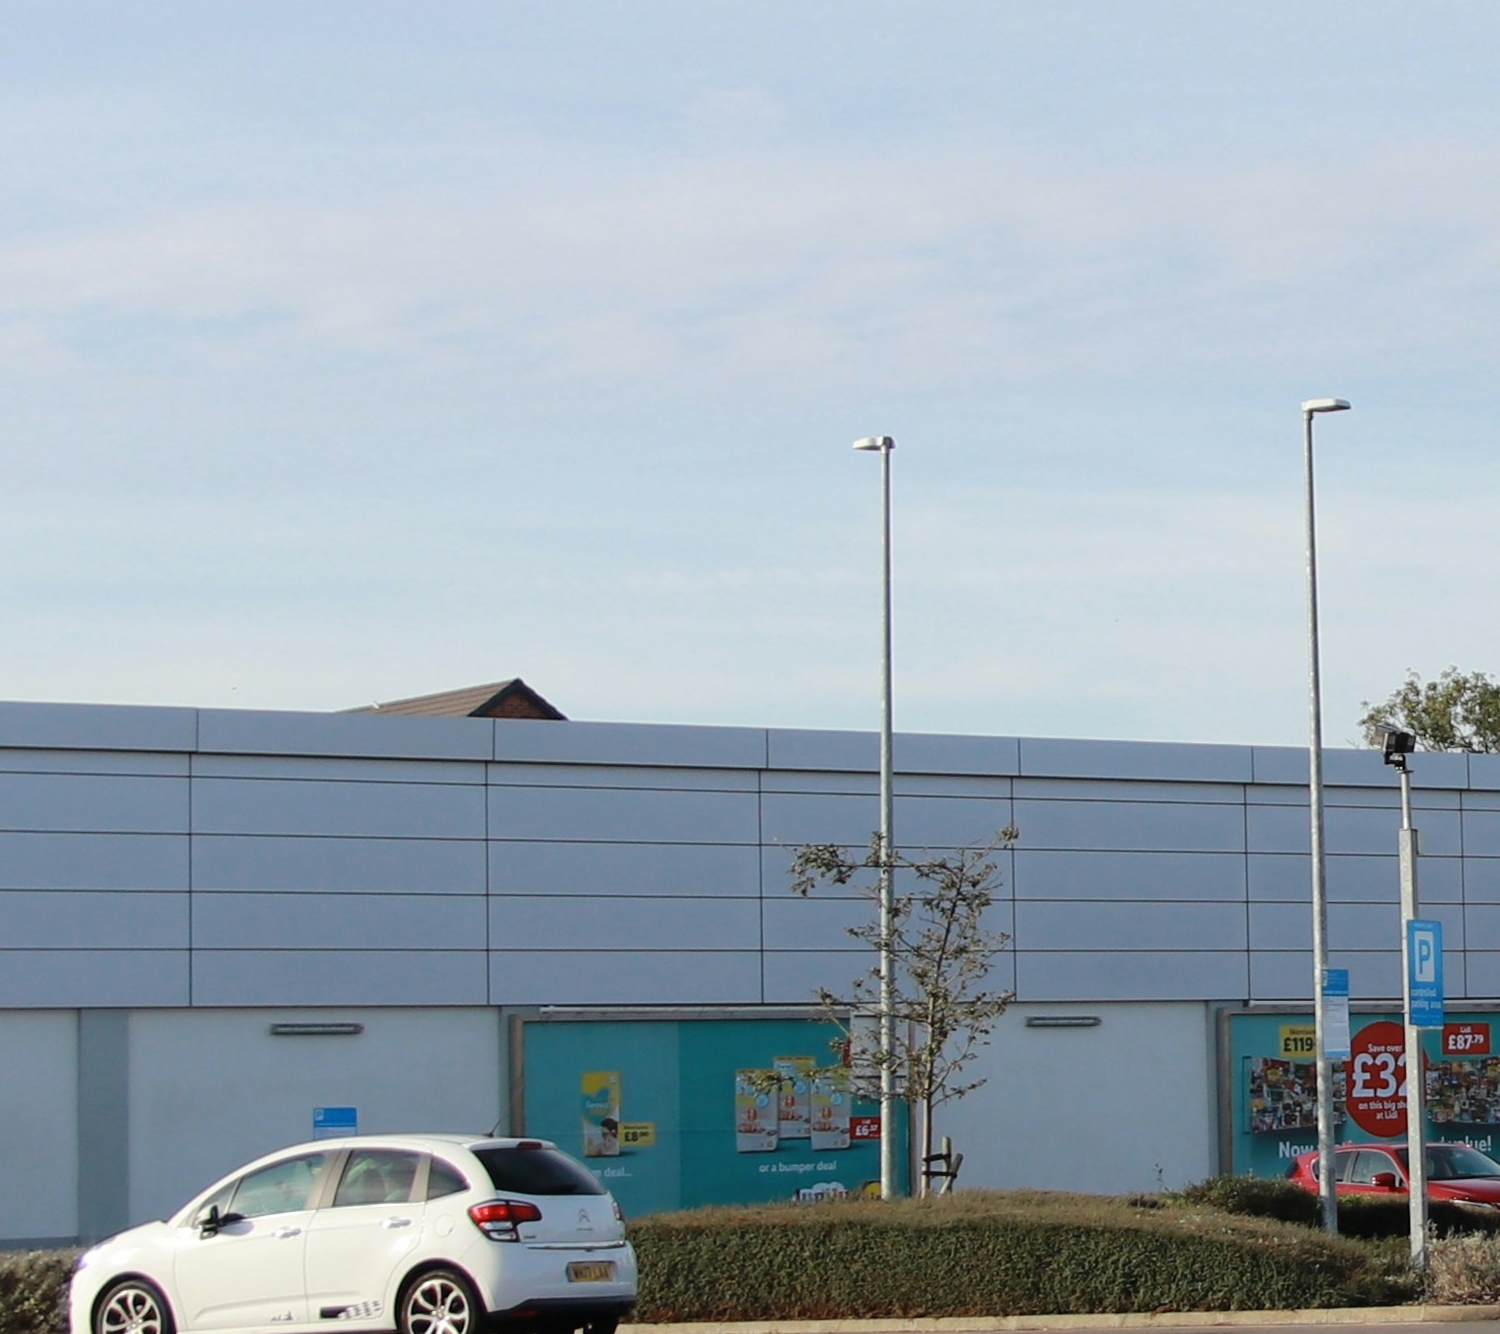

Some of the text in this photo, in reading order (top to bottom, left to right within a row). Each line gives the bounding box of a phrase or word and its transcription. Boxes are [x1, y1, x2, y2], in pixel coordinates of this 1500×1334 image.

[1367, 1043, 1403, 1053] Save over
[1447, 1034, 1484, 1050] £87.79
[1370, 1100, 1383, 1109] this
[1384, 1100, 1396, 1111] big
[758, 1164, 770, 1173] or
[778, 1162, 816, 1174] bumper
[816, 1160, 837, 1171] deal
